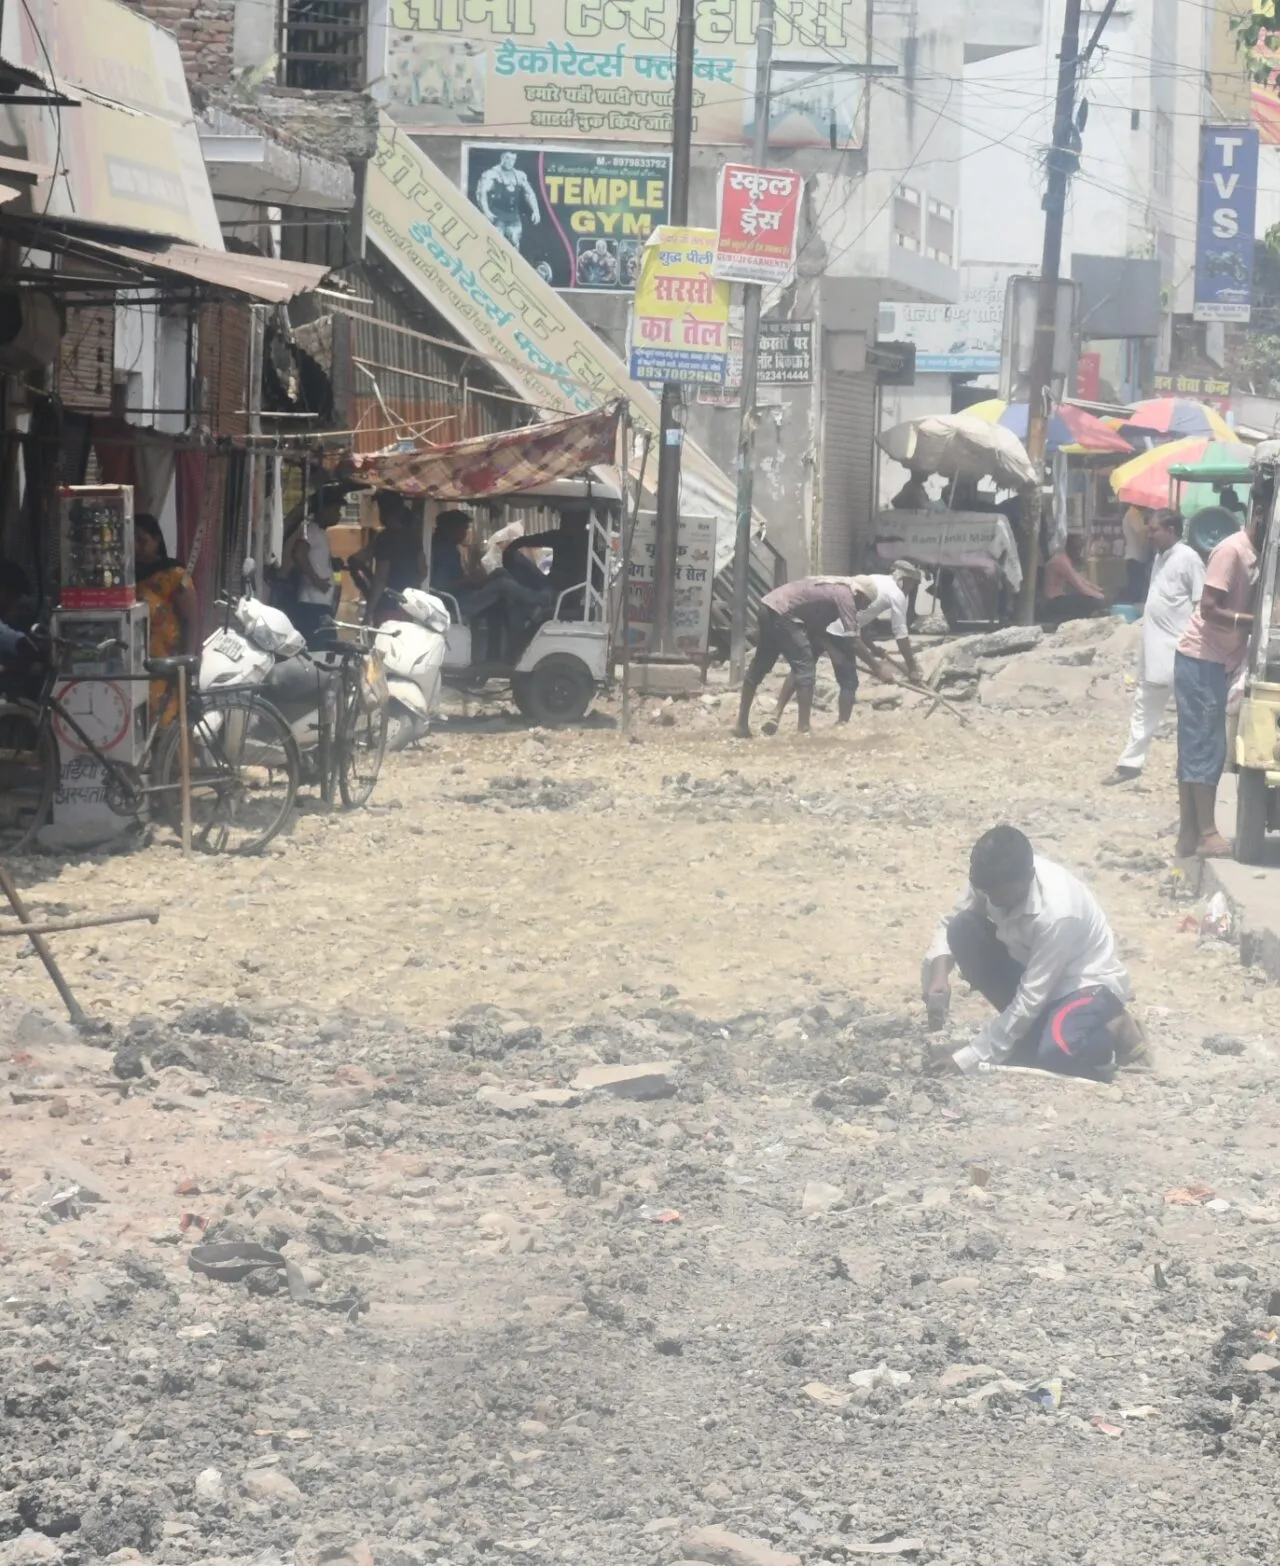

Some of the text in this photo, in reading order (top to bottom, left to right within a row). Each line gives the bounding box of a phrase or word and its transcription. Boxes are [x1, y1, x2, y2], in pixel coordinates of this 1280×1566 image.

[544, 175, 665, 209] TEMPLE
[729, 170, 796, 200] स्कूल
[1212, 136, 1243, 239] TVS
[570, 210, 652, 235] GYM
[740, 201, 783, 237] ड्रेस
[686, 249, 714, 265] पीली
[639, 311, 725, 347] का तेल
